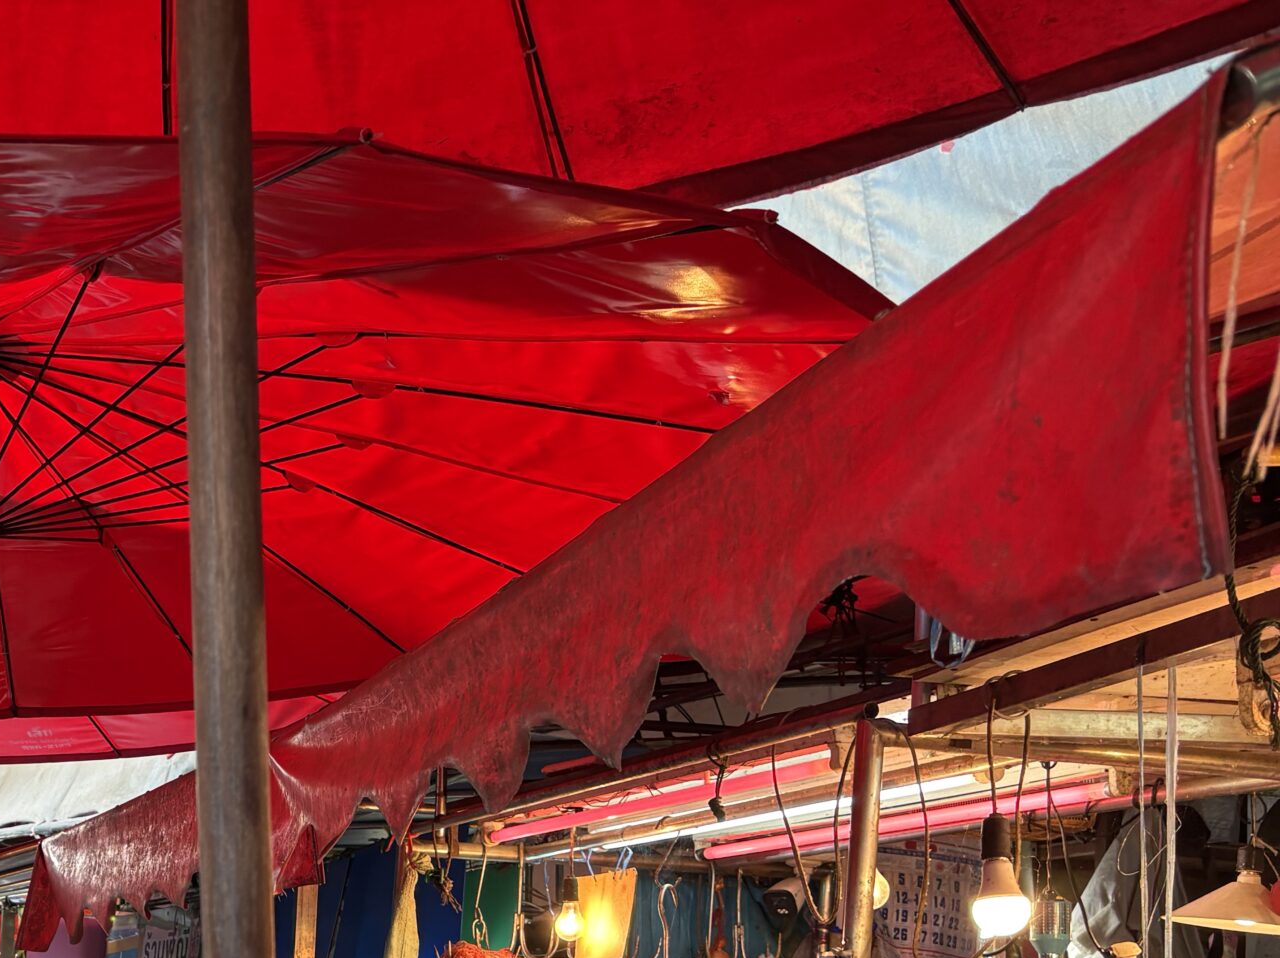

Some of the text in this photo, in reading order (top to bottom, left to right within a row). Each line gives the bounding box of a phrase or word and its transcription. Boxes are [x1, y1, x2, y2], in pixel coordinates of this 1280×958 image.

[898, 873, 905, 885] 5
[936, 878, 942, 890] 7
[896, 891, 908, 904] 12
[934, 896, 946, 909] 14
[895, 909, 908, 922] 19
[933, 914, 945, 928] 21
[948, 917, 959, 930] 22
[893, 928, 908, 940] 26
[932, 932, 944, 946] 28
